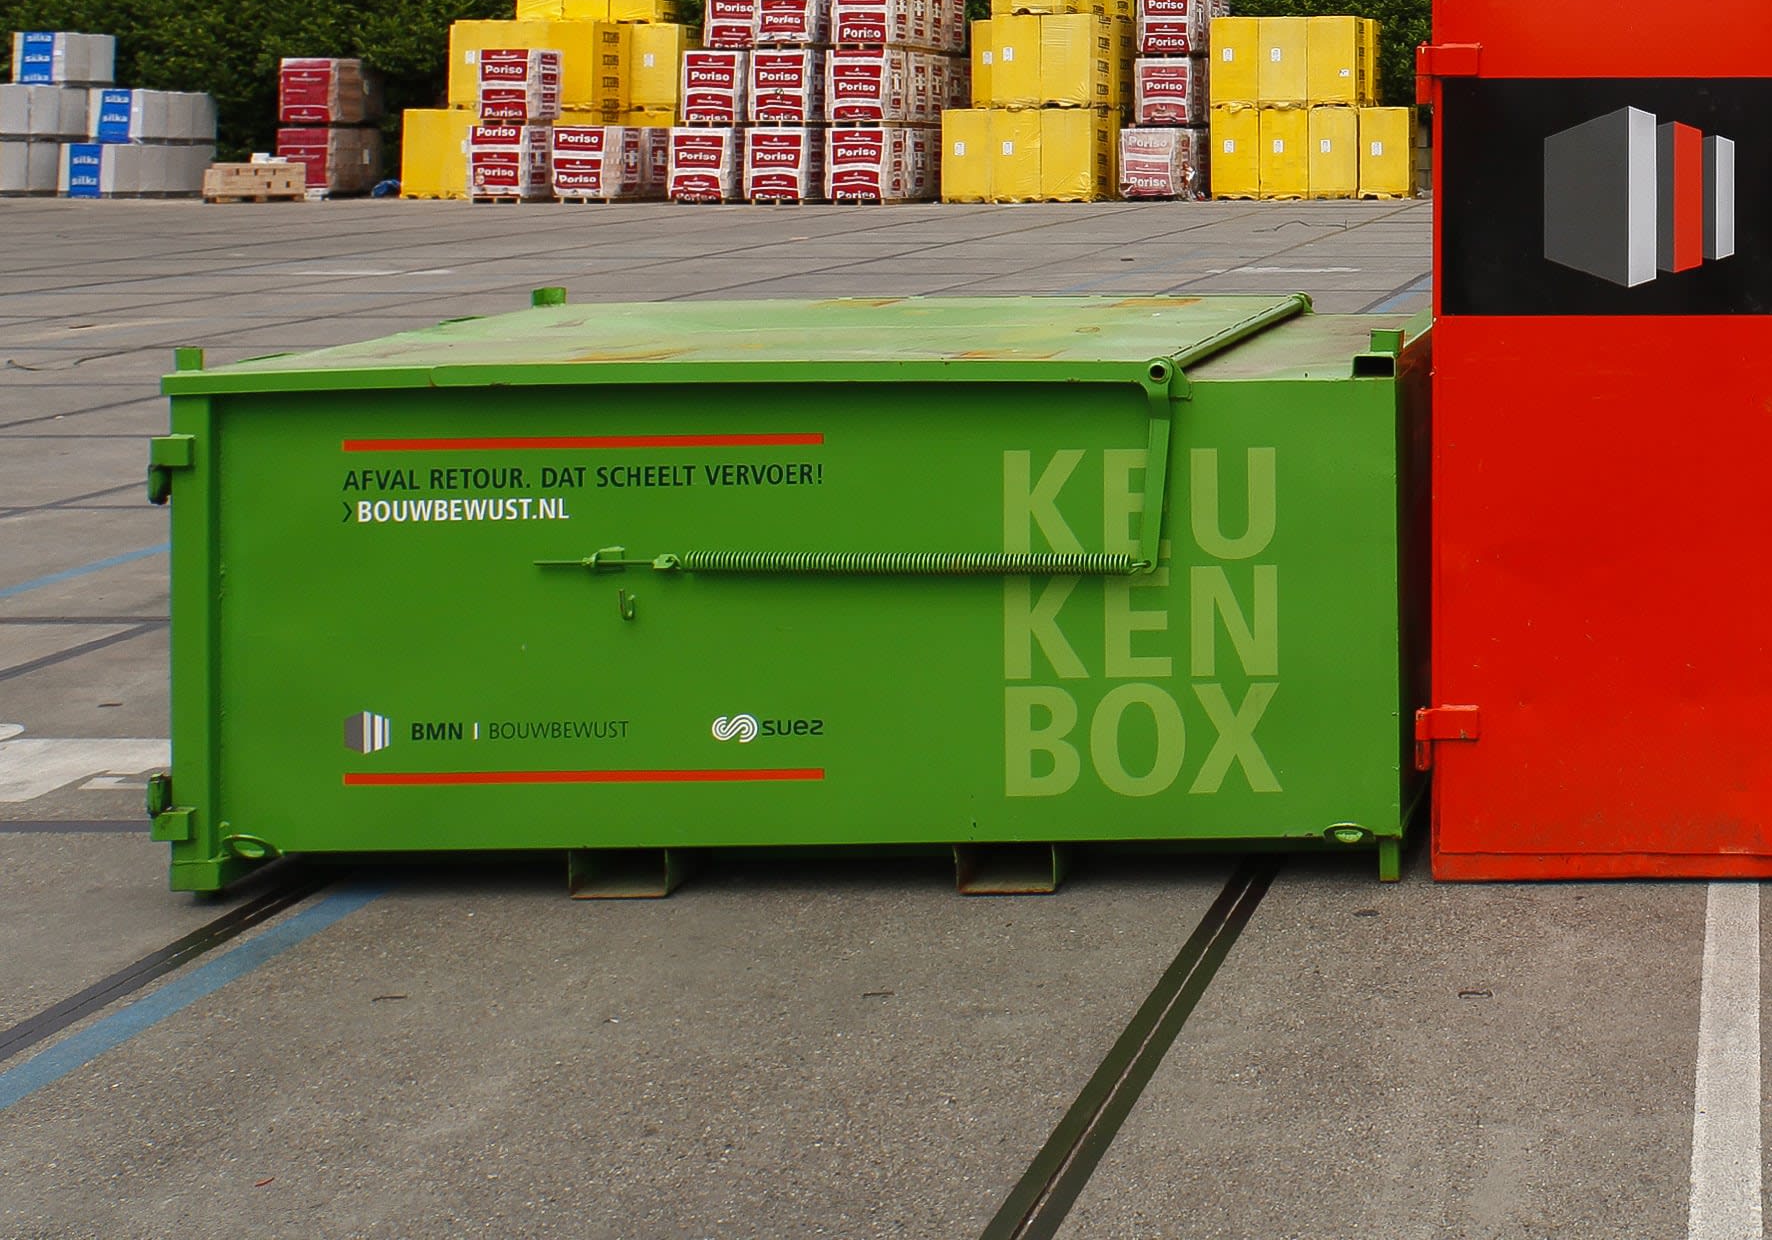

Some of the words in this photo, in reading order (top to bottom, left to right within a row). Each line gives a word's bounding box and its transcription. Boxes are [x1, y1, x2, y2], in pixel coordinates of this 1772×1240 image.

[716, 2, 753, 12] Poriso
[1148, 0, 1184, 9] Poriso
[1147, 37, 1184, 46] Poriso
[485, 65, 522, 74] Poriso
[691, 71, 730, 81] Poriso
[760, 72, 798, 80] Poriso
[838, 82, 876, 91] Poriso
[1146, 82, 1182, 90] Poriso
[476, 127, 516, 137] Poriso
[559, 133, 598, 143] Poriso
[679, 152, 716, 160] Poriso
[756, 152, 794, 160] Poriso
[837, 148, 876, 156] Poriso
[559, 175, 596, 183] Poriso
[342, 469, 421, 492] AFVAL
[430, 467, 531, 490] RETOUR.
[542, 466, 588, 488] DAT
[596, 465, 696, 488] SCHEELT
[704, 463, 824, 487] VERVOER!
[1004, 447, 1276, 560] KEU
[356, 497, 570, 524] BOUWBEWUST.NL
[1004, 565, 1279, 680] KEN
[410, 722, 463, 742] BMN
[488, 720, 629, 740] BOUWBEWUST
[1005, 682, 1283, 797] BOX
